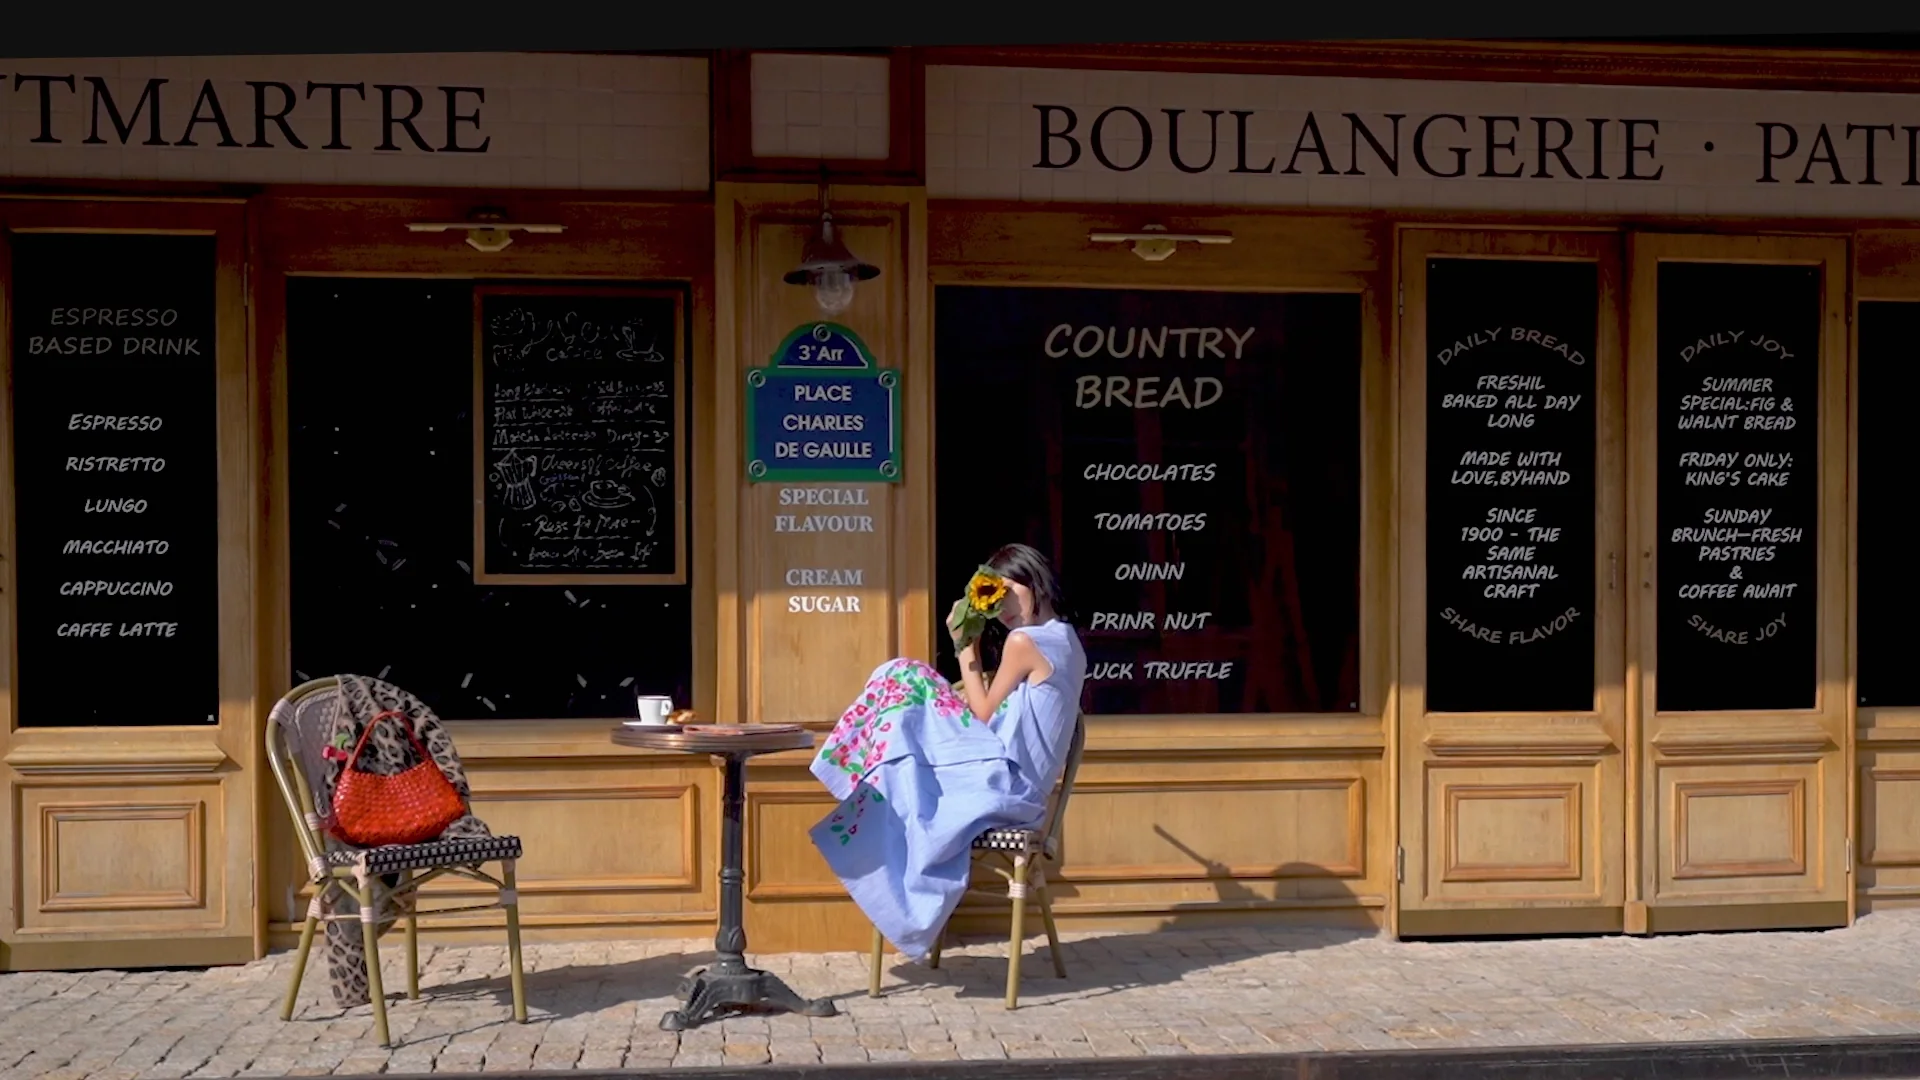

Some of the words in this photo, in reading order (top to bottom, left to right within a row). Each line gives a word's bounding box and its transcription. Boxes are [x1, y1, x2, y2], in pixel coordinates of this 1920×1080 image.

[0, 73, 491, 152] TMARTRE
[1032, 104, 1664, 182] BOULANGERIE
[1756, 122, 1920, 185] PATI
[51, 308, 177, 326] ESPRESSO
[29, 336, 112, 354] BASED
[124, 338, 200, 355] DRINK
[1045, 324, 1255, 359] COUNTRY
[1437, 327, 1501, 365] DAILY
[1511, 327, 1585, 365] BREAD
[1680, 331, 1744, 362] DAILY
[1751, 335, 1794, 359] JOY
[1477, 375, 1545, 390] FRESHIL
[1702, 377, 1773, 392] SUMMER
[794, 385, 852, 402] PLACE
[1076, 375, 1222, 409] BREAD
[1442, 394, 1498, 408] BAKED
[1505, 395, 1537, 409] ALL
[1544, 395, 1581, 411] DAY
[1780, 397, 1793, 411] &
[68, 413, 162, 431] ESPRESSO
[782, 414, 864, 432] CHARLES
[1488, 413, 1534, 428] LONG
[1678, 414, 1739, 429] WALNT
[1744, 416, 1796, 430] BREAD
[775, 442, 799, 459] DE
[802, 441, 872, 459] GAULLE
[1460, 451, 1511, 466] MADE
[1517, 451, 1561, 466] WITH
[66, 457, 165, 472] RISTRETTO
[1679, 452, 1739, 468] FRIDAY
[1744, 452, 1793, 469] ONLY:
[1084, 463, 1216, 481] CHOCOLATES
[1748, 472, 1790, 486] CAKE
[85, 498, 147, 513] LUNGO
[779, 488, 868, 506] SPECIAL
[775, 515, 873, 533] FLAVOUR
[1094, 513, 1207, 531] TOMATOES
[1486, 508, 1537, 523] SINCE
[1704, 509, 1772, 525] SUNDAY
[1462, 527, 1503, 541] 1900
[1528, 527, 1561, 542] THE
[63, 540, 169, 554] MACCHIATO
[1487, 546, 1536, 561] SAME
[1699, 546, 1776, 561] PASTRIES
[785, 569, 863, 586] CREAM
[1115, 562, 1185, 580] ONINN
[1463, 564, 1558, 580] ARTISANAL
[1729, 566, 1743, 579] &
[60, 580, 173, 596] CAPPUCCINO
[1484, 583, 1540, 598] CRAFT
[1679, 584, 1738, 599] COFFEE
[1743, 583, 1797, 598] AWAIT
[788, 596, 861, 613] SUGAR
[57, 623, 112, 637] CAFFE
[119, 622, 178, 637] LATTE
[1091, 612, 1155, 630] PRINR
[1164, 612, 1212, 630] NUT
[1440, 607, 1502, 643] SHARE
[1509, 607, 1580, 644] FLAVOR
[1688, 615, 1748, 644] SHARE
[1756, 612, 1786, 641] JOY
[1144, 662, 1233, 679] TRUFFLE
